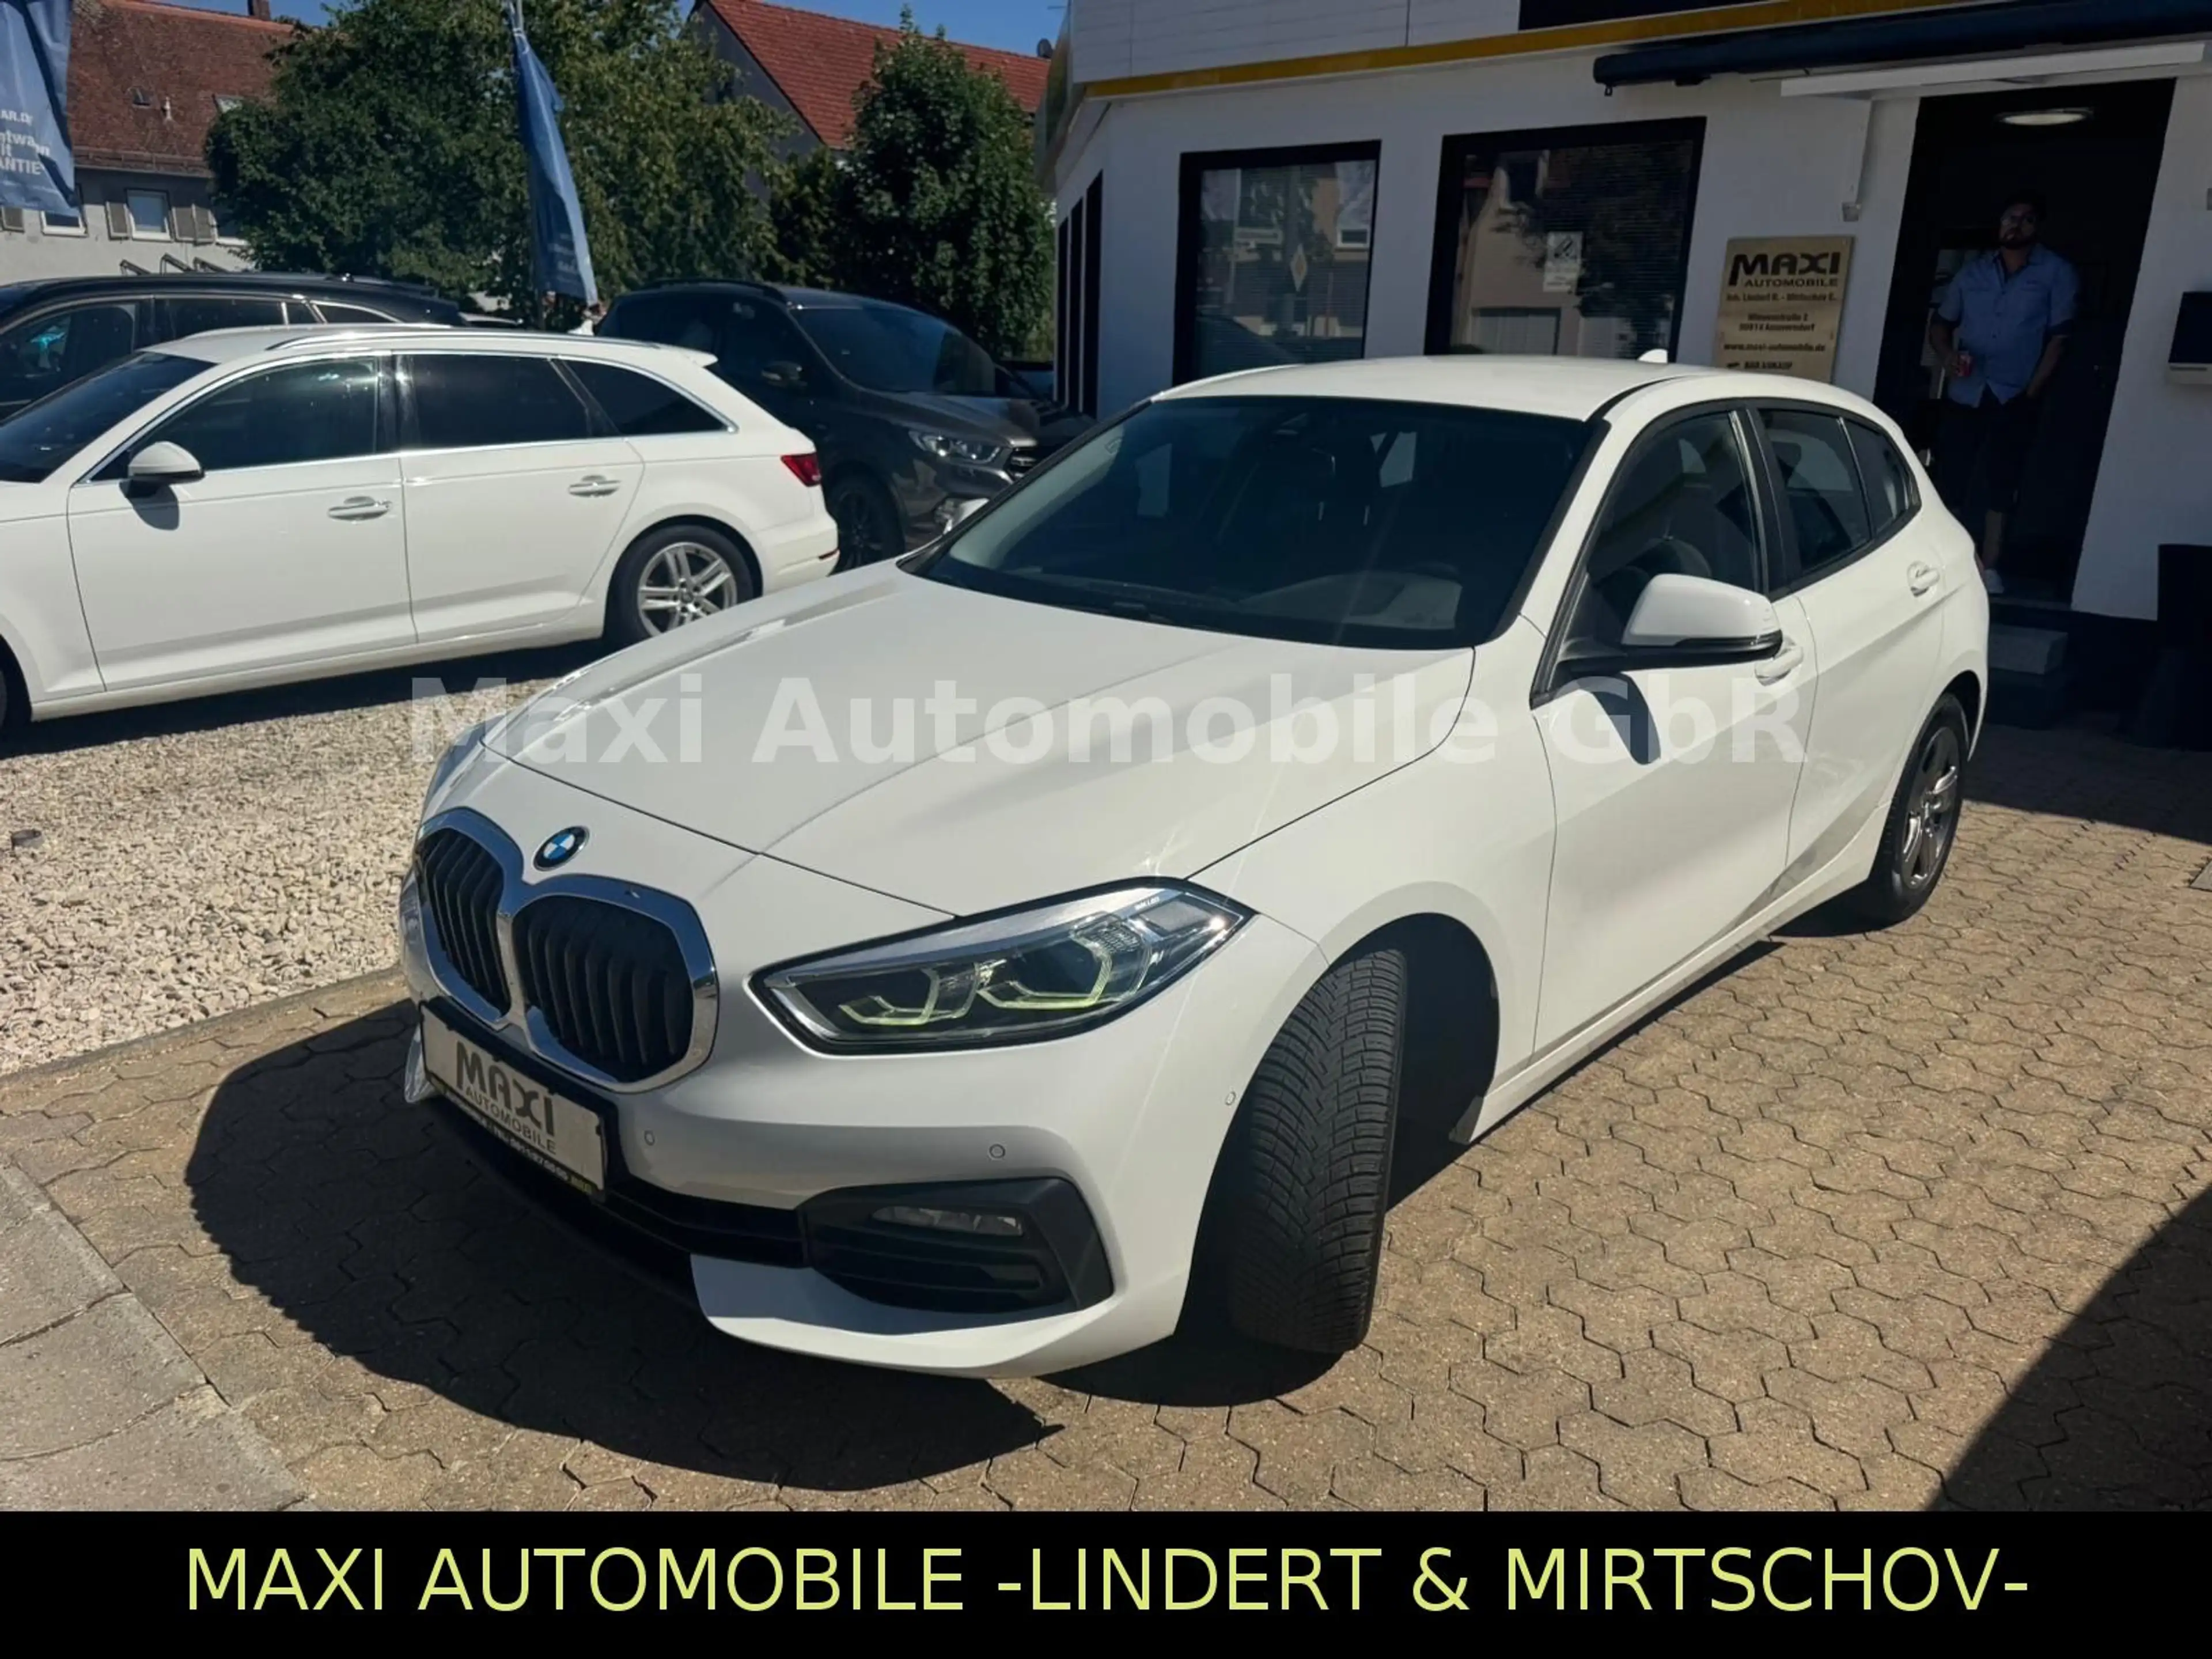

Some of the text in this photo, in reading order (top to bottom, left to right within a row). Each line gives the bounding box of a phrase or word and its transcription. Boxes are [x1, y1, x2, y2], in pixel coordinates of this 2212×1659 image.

[1728, 252, 1840, 286] MAXI
[1745, 279, 1838, 287] AUTOMOBILE
[456, 1040, 555, 1137] MAXI
[465, 1086, 557, 1156] AUTOMOBILE
